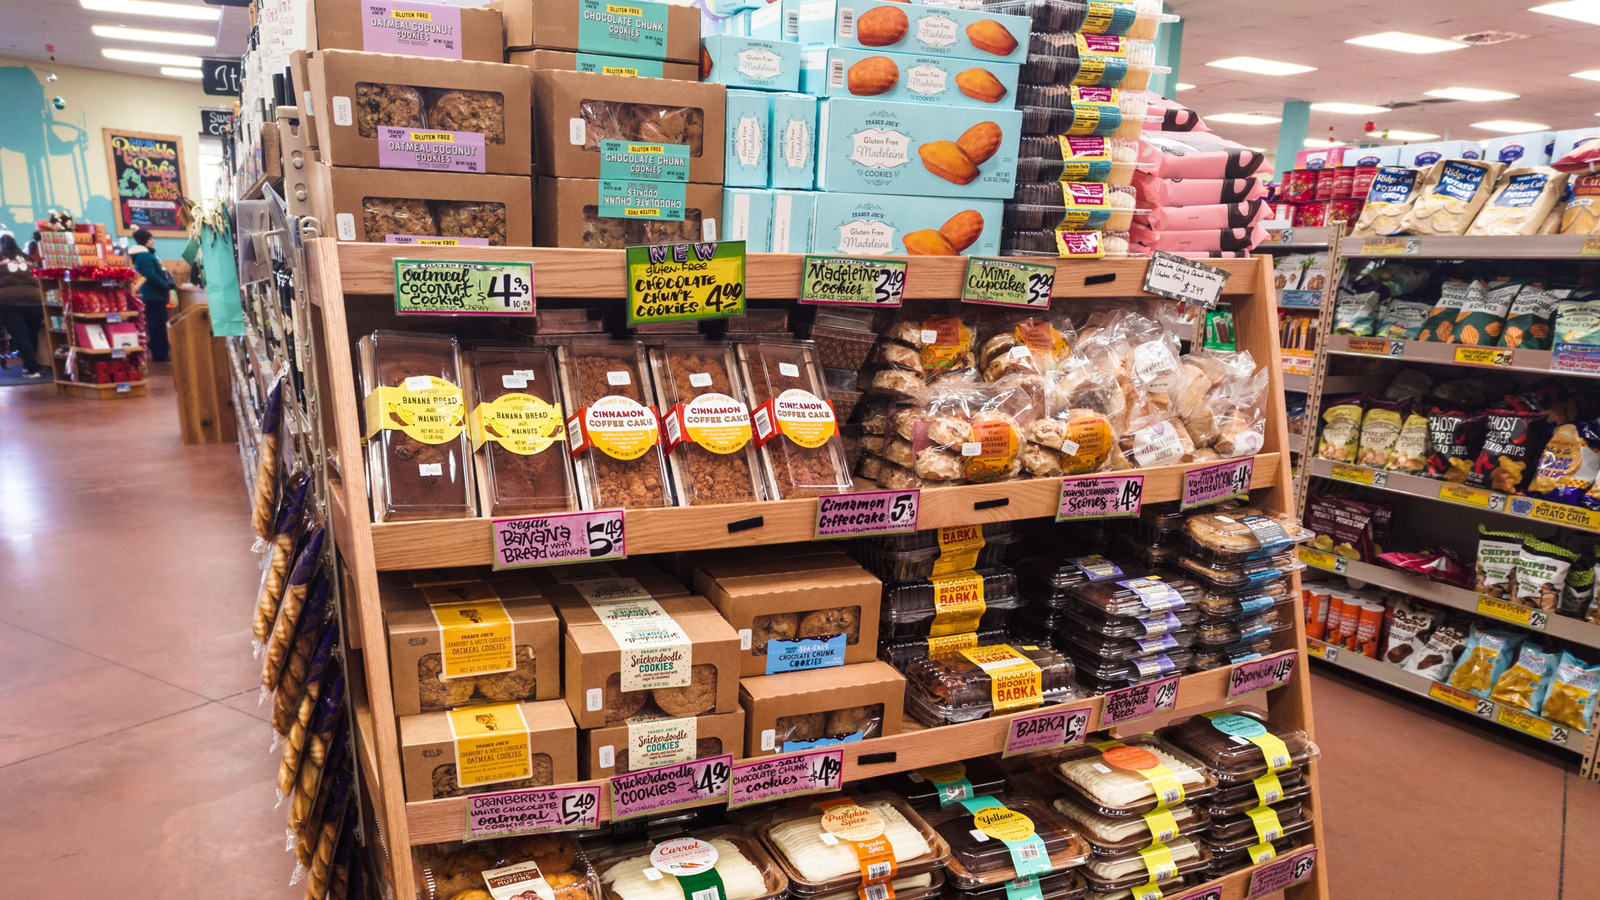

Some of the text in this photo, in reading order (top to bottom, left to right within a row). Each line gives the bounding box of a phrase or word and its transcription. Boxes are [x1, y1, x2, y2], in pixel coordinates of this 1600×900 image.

[371, 17, 453, 35] OATMEAL COCONUT
[584, 10, 664, 32] CHOCOLATE CHUNK
[396, 30, 430, 41] COOKIES
[608, 24, 640, 37] COOKIES
[864, 136, 899, 146] Gluten Free
[388, 141, 476, 156] OATMEAL COCONUT
[856, 145, 905, 159] Madeleine
[415, 153, 451, 163] COOKIES
[605, 153, 685, 167] CHOCOLATE CHUNK
[630, 164, 662, 174] COOKIES
[1444, 166, 1482, 182] Ridge Cut
[1377, 174, 1397, 184] Ridge
[1442, 175, 1475, 191] POTATO
[627, 188, 658, 197] COOKIES
[1375, 184, 1408, 193] POTATO
[1446, 185, 1472, 199] CHIPS
[1508, 180, 1544, 193] Ridge Cut
[1381, 192, 1406, 201] CHIPS
[1504, 190, 1539, 198] POTATO
[603, 195, 681, 208] CHOCOLATE CHUNK
[850, 228, 871, 236] Gluten
[843, 237, 890, 249] Madeleine
[648, 242, 718, 264] NEW
[402, 269, 470, 283] Oatmeal
[635, 274, 716, 292] CHOCOLATE
[811, 280, 865, 295] Cookies
[968, 274, 1026, 294] Cupcakes
[642, 289, 694, 304] CHUNK
[433, 396, 458, 405] BREAD
[779, 402, 822, 410] CINNAMON
[592, 410, 644, 418] CINNAMON
[691, 406, 741, 414] CINNAMON
[777, 410, 806, 418] COFFEE
[418, 415, 446, 423] WALNUTS
[589, 420, 625, 428] COFFEE
[724, 414, 749, 422] CAKE
[1073, 478, 1100, 488] mini
[821, 498, 886, 512] Cinnamon
[1068, 497, 1109, 512] Scones
[1536, 505, 1565, 519] POTATO
[1567, 513, 1590, 524] CHIPS
[507, 519, 550, 532] vegan
[943, 528, 979, 545] BABKA
[550, 540, 571, 550] with
[1517, 567, 1554, 580] PICKLE
[940, 583, 978, 594] BROOKLYN
[940, 591, 979, 606] BABKA
[452, 643, 506, 655] OATMEAL COOKIES
[779, 650, 834, 661] CHOCOLATE CHUNK
[631, 651, 683, 668] Snickerdoodle
[789, 658, 822, 667] COOKIES
[639, 662, 674, 673] COOKIES
[997, 677, 1036, 689] BROOKLYN
[997, 684, 1037, 702] BABKA
[1111, 685, 1150, 703] Sea Salt
[1016, 715, 1065, 738] BABKA
[638, 730, 688, 748] Snickerdoodle
[646, 741, 680, 753] COOKIES
[466, 751, 522, 764] OATMEAL COOKIES
[747, 755, 806, 773] sea salt
[778, 762, 809, 775] CHUNK
[612, 765, 696, 795] Snickerdoodle
[746, 775, 798, 793] cookies
[548, 792, 558, 800] &
[478, 810, 549, 826] oatmeal
[824, 809, 869, 822] Pumpkin
[840, 817, 867, 826] Spice
[977, 812, 1015, 824] Yellow
[660, 841, 700, 856] Carrot
[497, 875, 531, 886] MUFFINS
